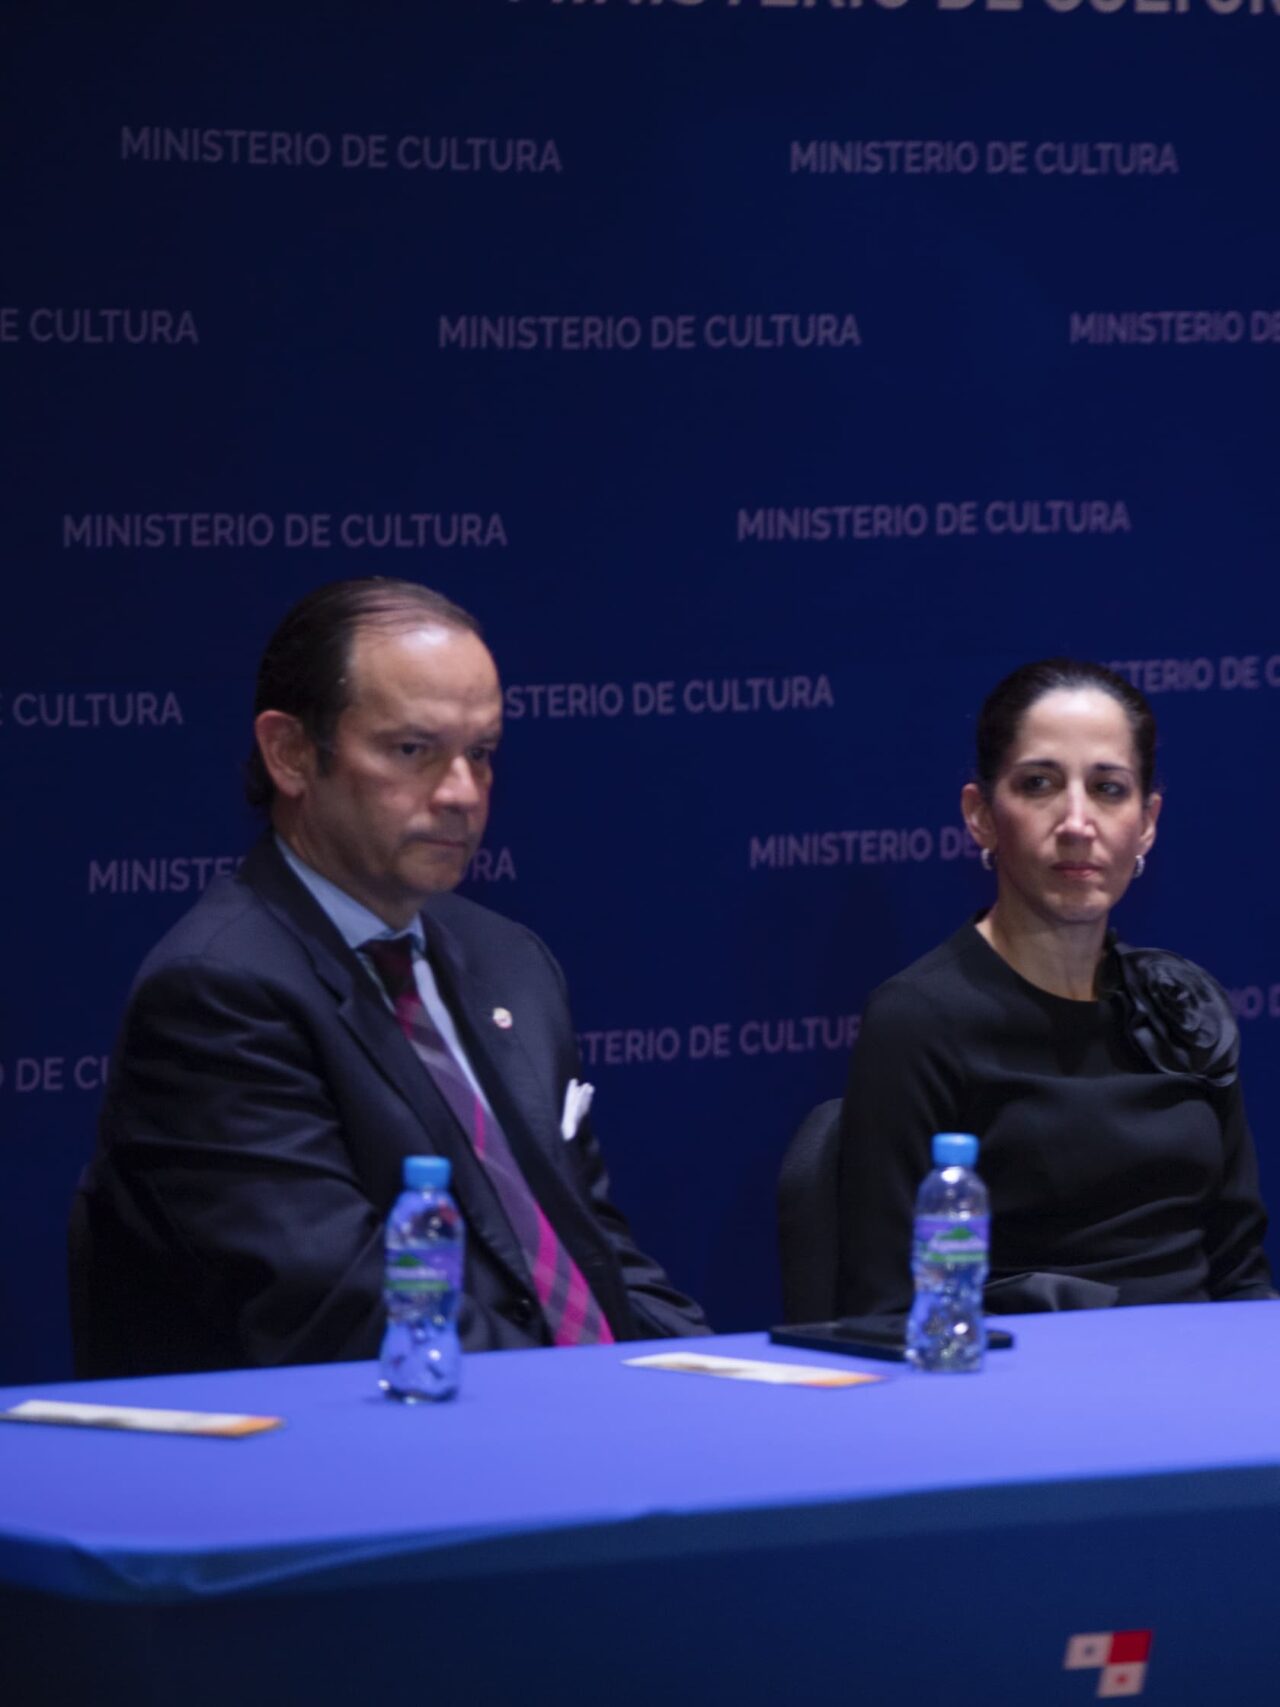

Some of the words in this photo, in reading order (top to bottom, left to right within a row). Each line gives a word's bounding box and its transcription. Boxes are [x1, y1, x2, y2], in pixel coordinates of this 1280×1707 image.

[121, 126, 332, 167] MINISTERIO
[341, 133, 388, 169] DE
[397, 135, 563, 173] CULTURA
[791, 140, 978, 174] MINISTERIO
[987, 141, 1027, 174] DE
[1035, 142, 1177, 175] CULTURA
[29, 308, 199, 344] CULTURA
[439, 316, 641, 349] MINISTERIO
[651, 315, 695, 349] DE
[704, 313, 861, 348] CULTURA
[1071, 311, 1243, 343] MINISTERIO
[64, 513, 274, 548] MINISTERIO
[285, 513, 331, 547] DE
[340, 513, 508, 548] CULTURA
[738, 503, 928, 540] MINISTERIO
[936, 501, 977, 535] DE
[985, 500, 1130, 533] CULTURA
[1219, 655, 1259, 690] DE
[12, 691, 183, 727] CULTURA
[632, 680, 676, 716] DE
[683, 673, 835, 713] CULTURA
[750, 828, 933, 869] MINISTERIO
[688, 1022, 732, 1059] DE
[15, 1056, 64, 1092] DE
